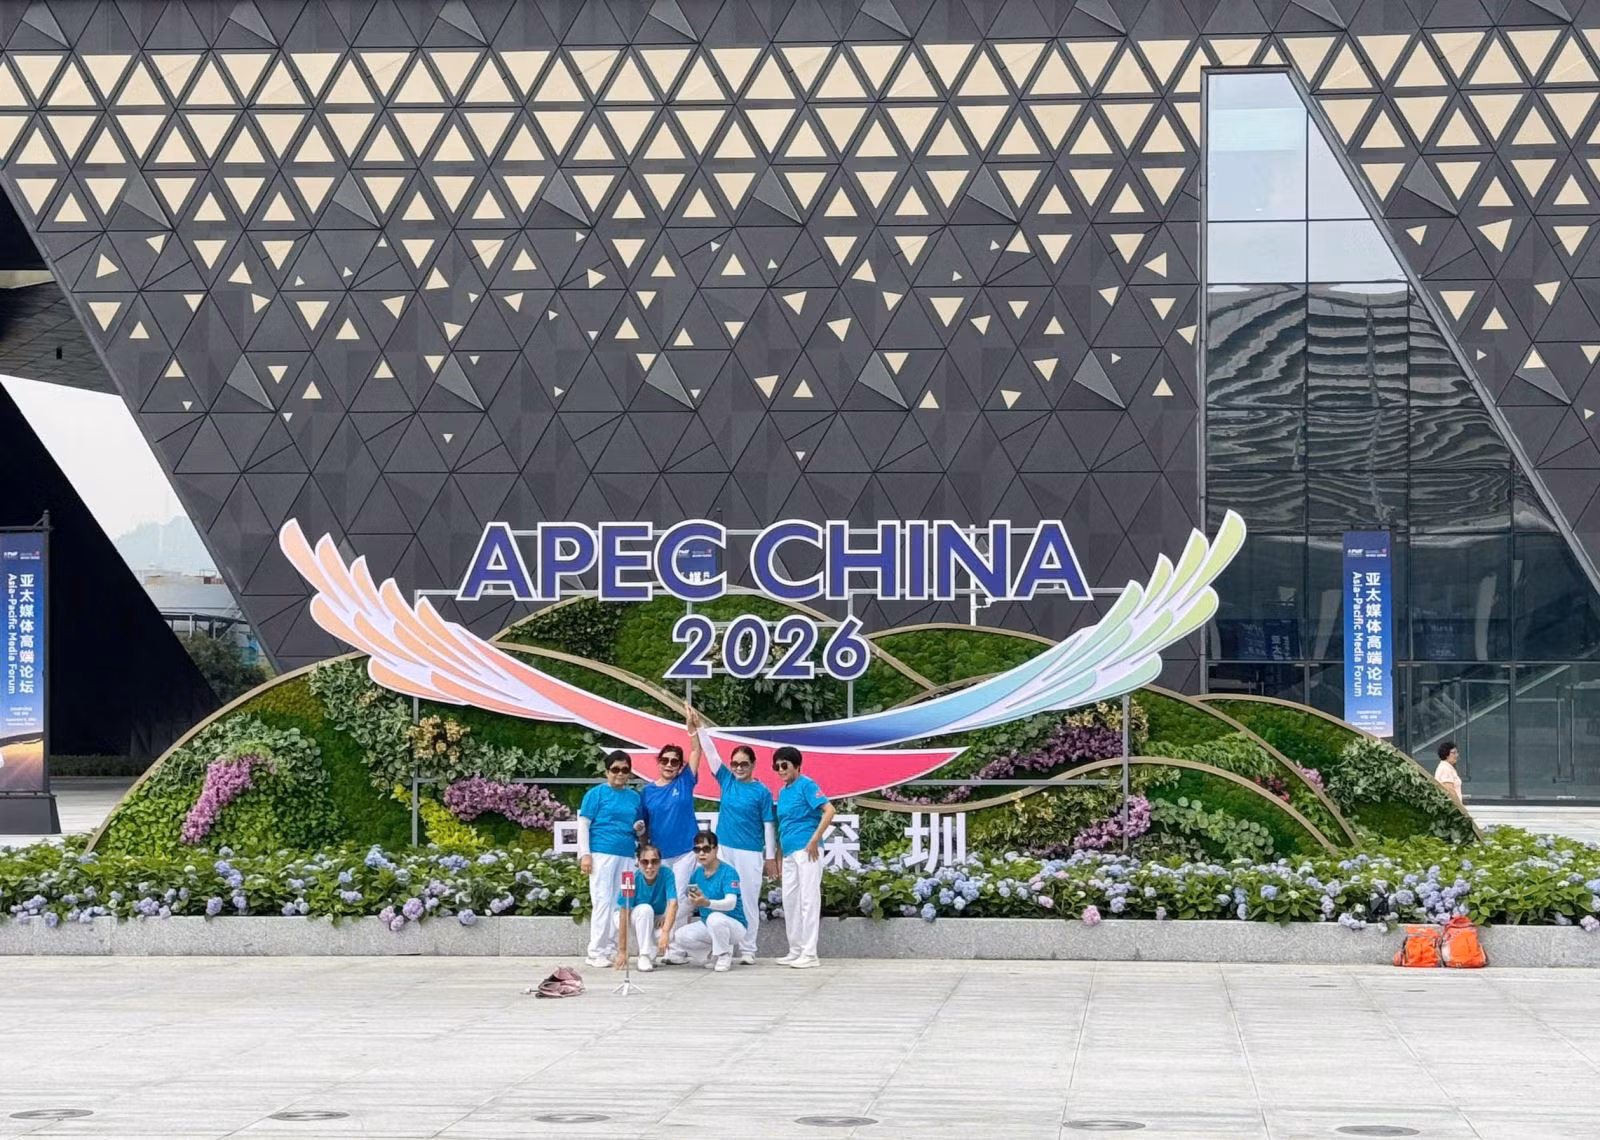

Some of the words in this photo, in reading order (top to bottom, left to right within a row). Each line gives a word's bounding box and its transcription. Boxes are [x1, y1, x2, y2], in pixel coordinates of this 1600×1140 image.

[455, 519, 728, 601] APEC
[749, 519, 1094, 601] CHINA
[8, 573, 17, 630] Asia-Pacific
[1352, 571, 1363, 630] Asia-Pacific
[8, 632, 17, 661] Media
[19, 573, 35, 695] 亚太媒体高端论坛
[662, 613, 871, 681] 2026
[1353, 632, 1364, 662] Media
[1365, 572, 1383, 697] 亚太媒体高端论坛
[8, 663, 17, 694] Forum
[1353, 665, 1364, 697] Forum
